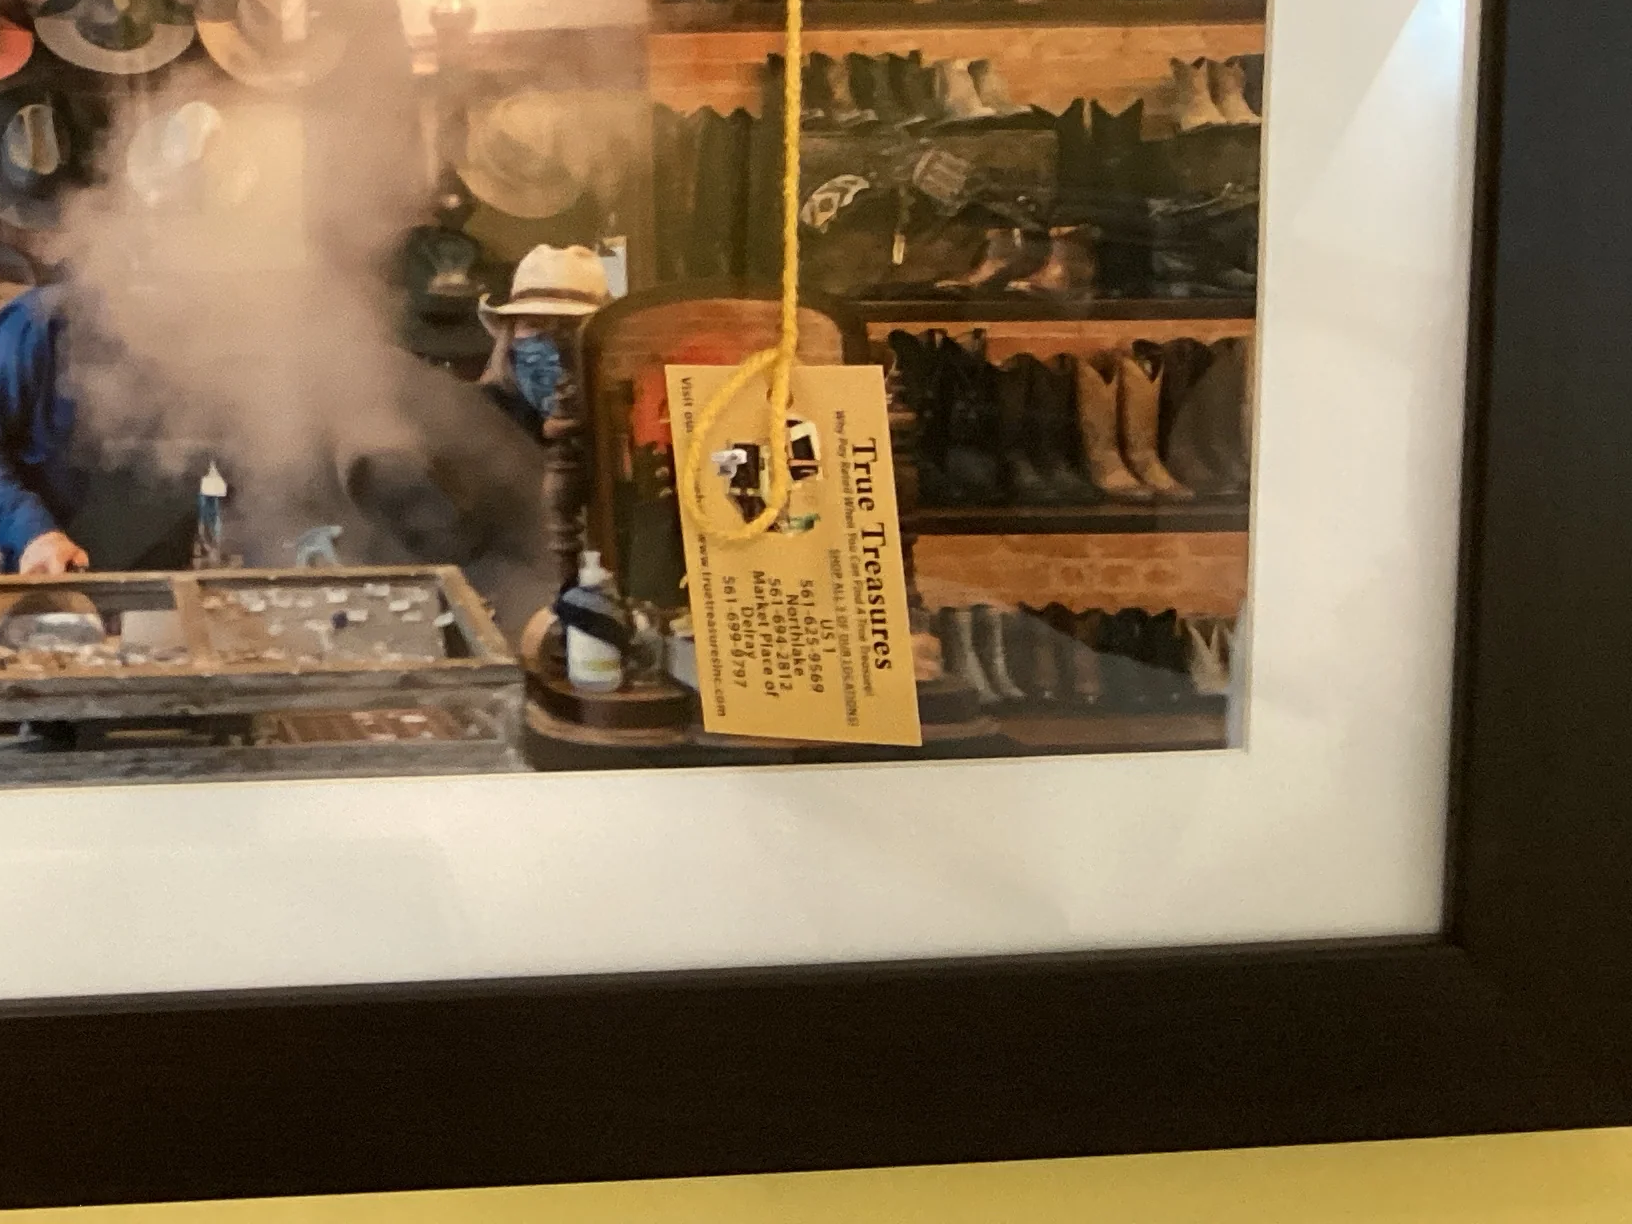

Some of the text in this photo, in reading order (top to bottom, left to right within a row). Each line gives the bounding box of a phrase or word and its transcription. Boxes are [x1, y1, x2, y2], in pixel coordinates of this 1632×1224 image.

[681, 377, 694, 407] Visit
[834, 411, 846, 434] Why
[836, 438, 849, 458] Pay
[840, 462, 853, 494] Retail
[844, 497, 856, 528] When
[846, 533, 858, 552] You
[852, 438, 893, 671] True Treasures
[830, 548, 844, 579] SHOP
[849, 556, 862, 576] Can
[832, 583, 845, 602] ALL
[853, 580, 866, 604] Find
[741, 606, 757, 660] Delray
[752, 570, 779, 698] Market Place of
[768, 578, 793, 691] 561-694-2812
[820, 619, 835, 640] US
[836, 615, 848, 628] OF
[856, 618, 868, 642] True
[786, 594, 806, 677] Northlake
[800, 580, 824, 693] 561-625-9569
[838, 634, 851, 658] OUR
